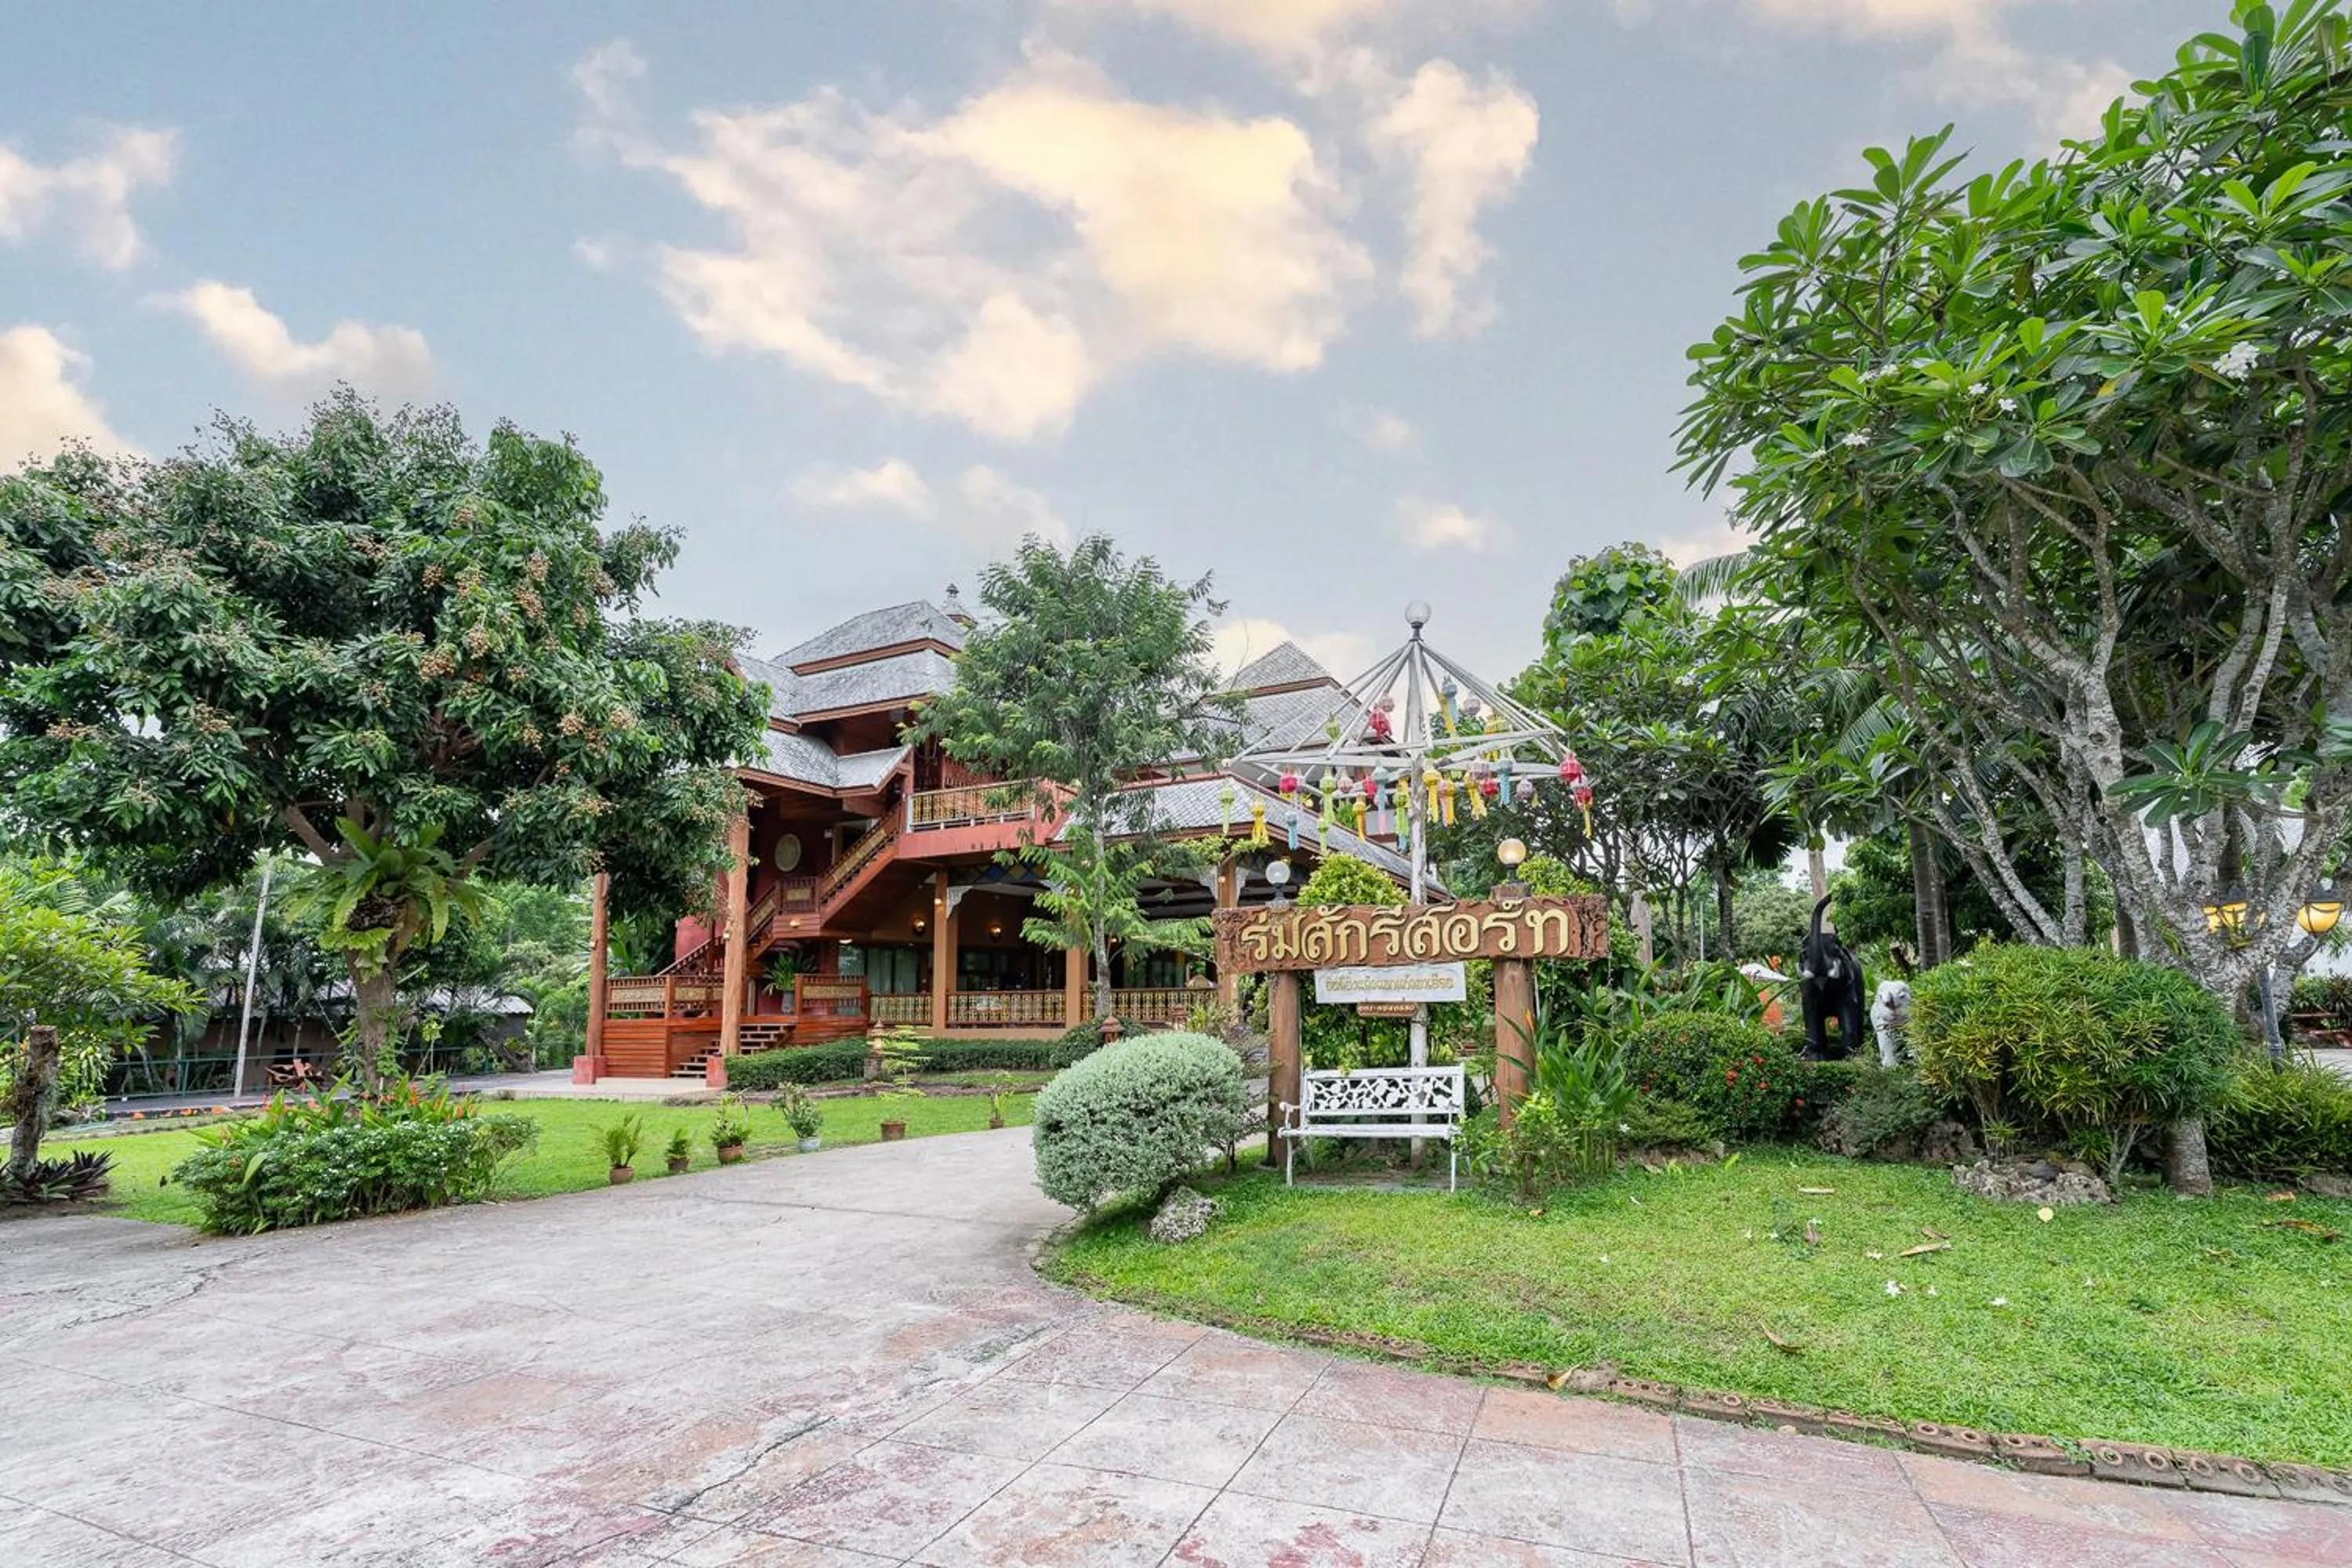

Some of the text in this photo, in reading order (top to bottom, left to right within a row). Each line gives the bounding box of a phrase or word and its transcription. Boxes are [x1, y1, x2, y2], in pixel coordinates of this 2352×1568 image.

[1240, 899, 1570, 961] ร่มสักรีสอร์ท
